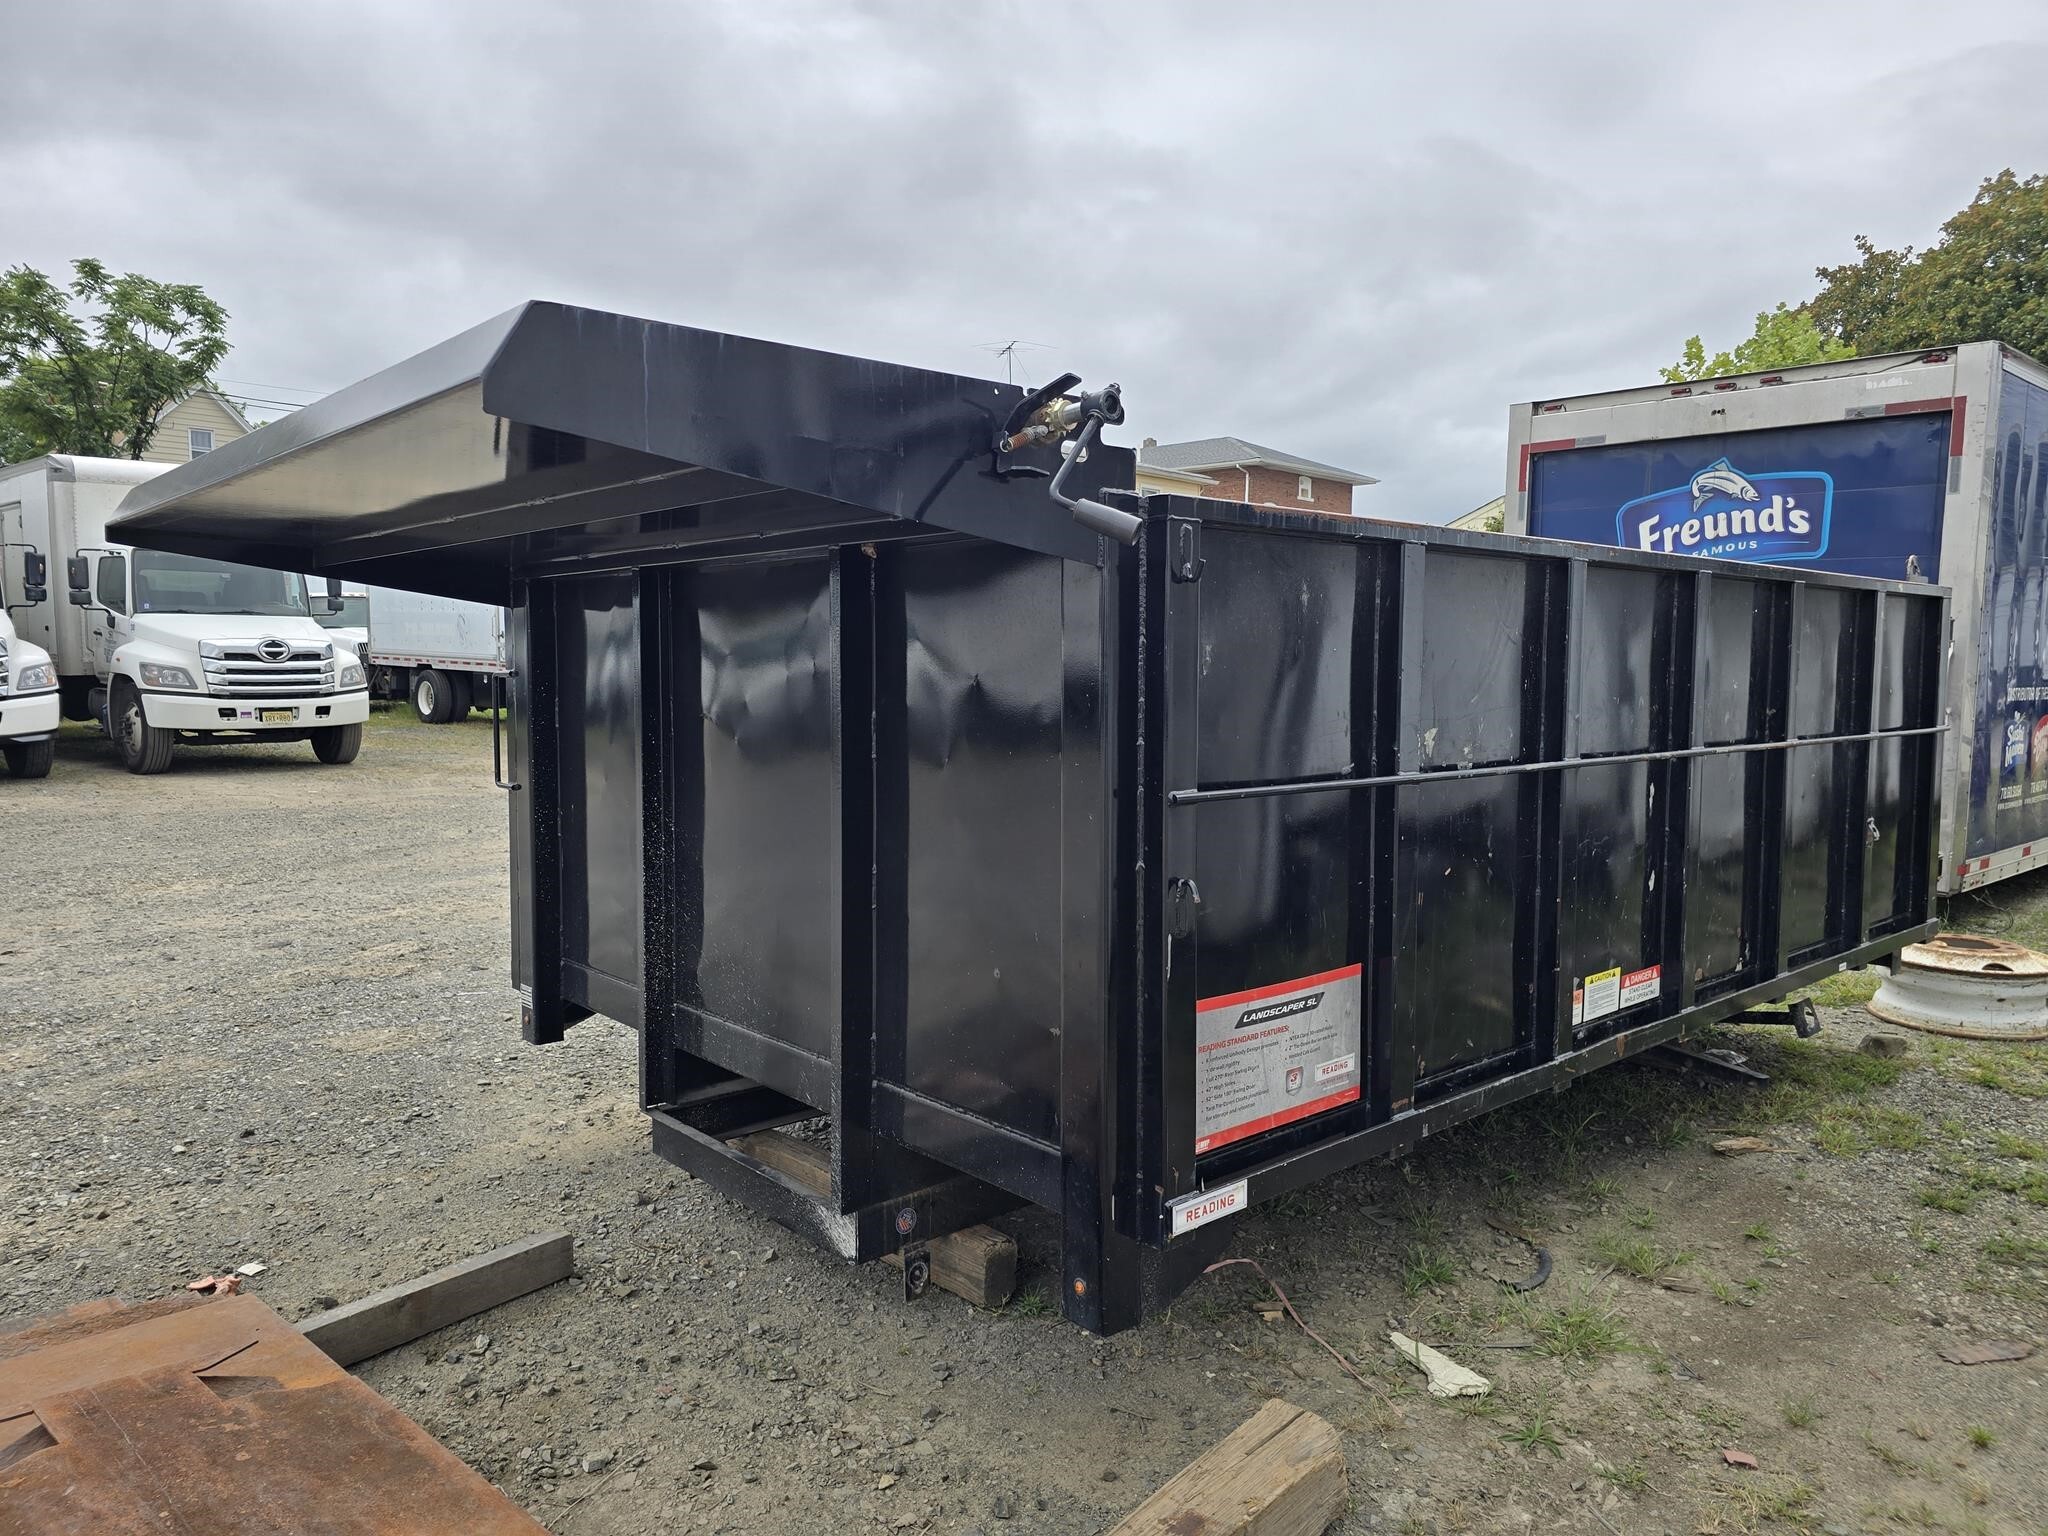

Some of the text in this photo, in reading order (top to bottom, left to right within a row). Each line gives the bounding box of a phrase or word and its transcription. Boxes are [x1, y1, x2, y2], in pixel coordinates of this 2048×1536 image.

[1638, 495, 1810, 552] Freund's
[1630, 971, 1652, 983] DANGER
[1243, 998, 1318, 1022] LANDSCAPER SL
[1198, 1025, 1289, 1053] READING STANDARD FEATURES:
[1322, 1061, 1348, 1075] READING
[1186, 1194, 1235, 1223] READING
